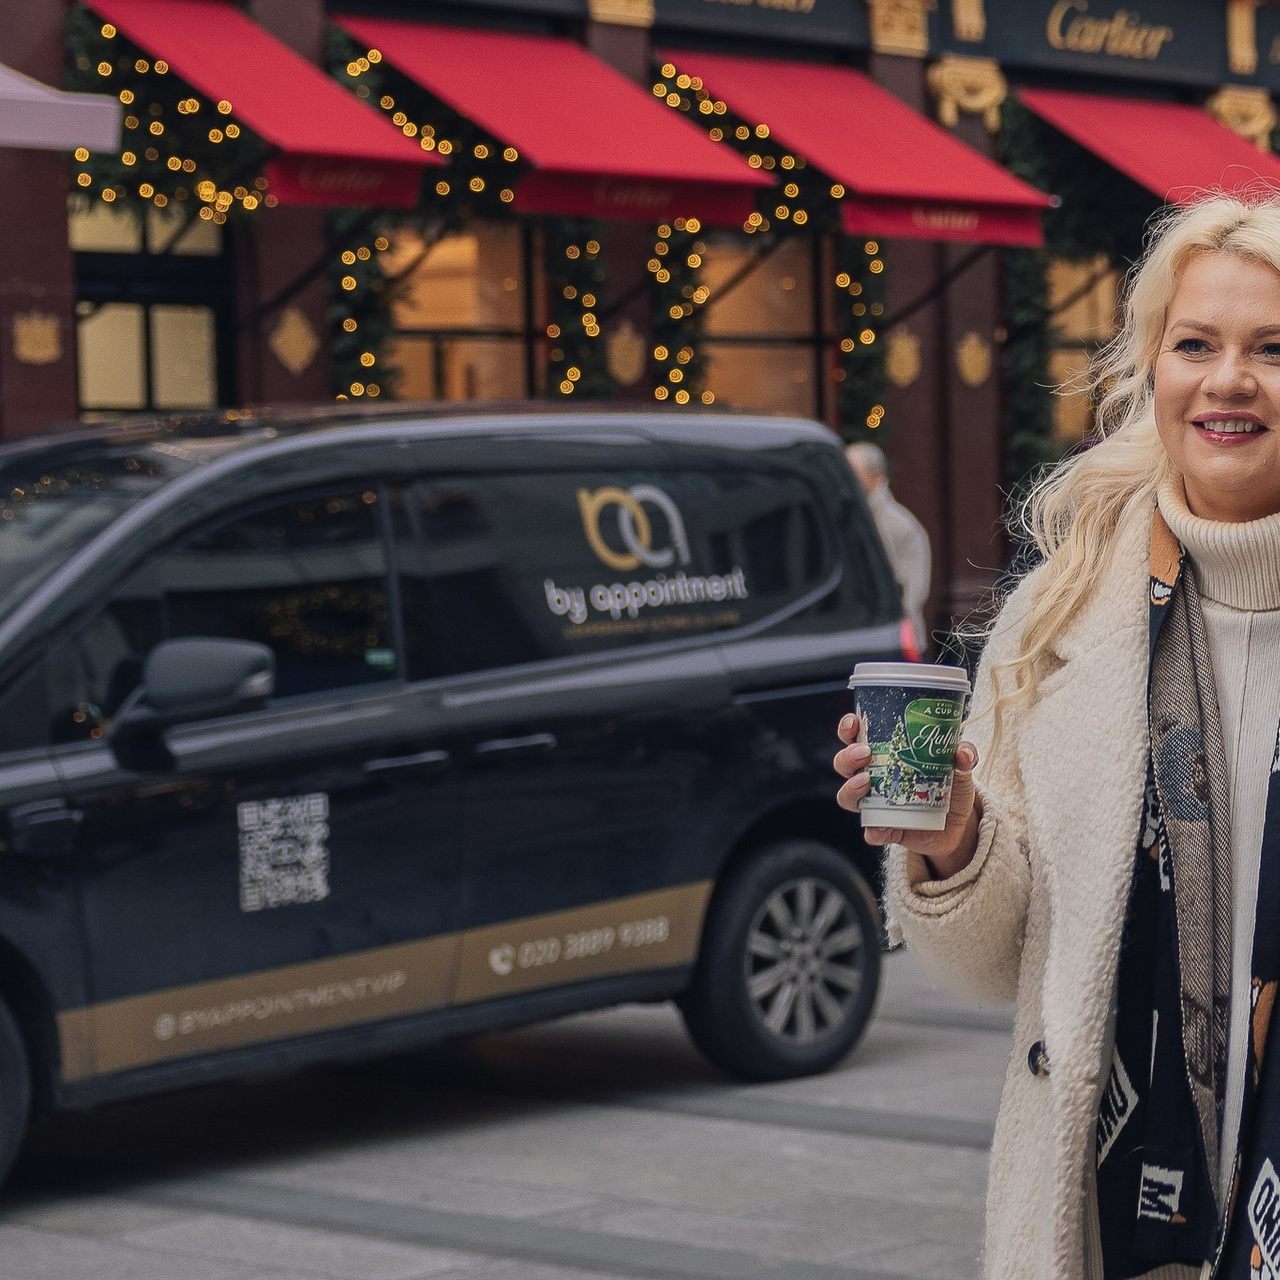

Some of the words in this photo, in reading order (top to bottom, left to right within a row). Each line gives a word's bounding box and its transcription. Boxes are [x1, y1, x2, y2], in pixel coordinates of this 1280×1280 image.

[544, 578, 588, 625] by
[589, 566, 749, 620] appointment
[923, 706, 932, 715] A
[934, 706, 952, 716] CUP
[517, 937, 561, 969] 020
